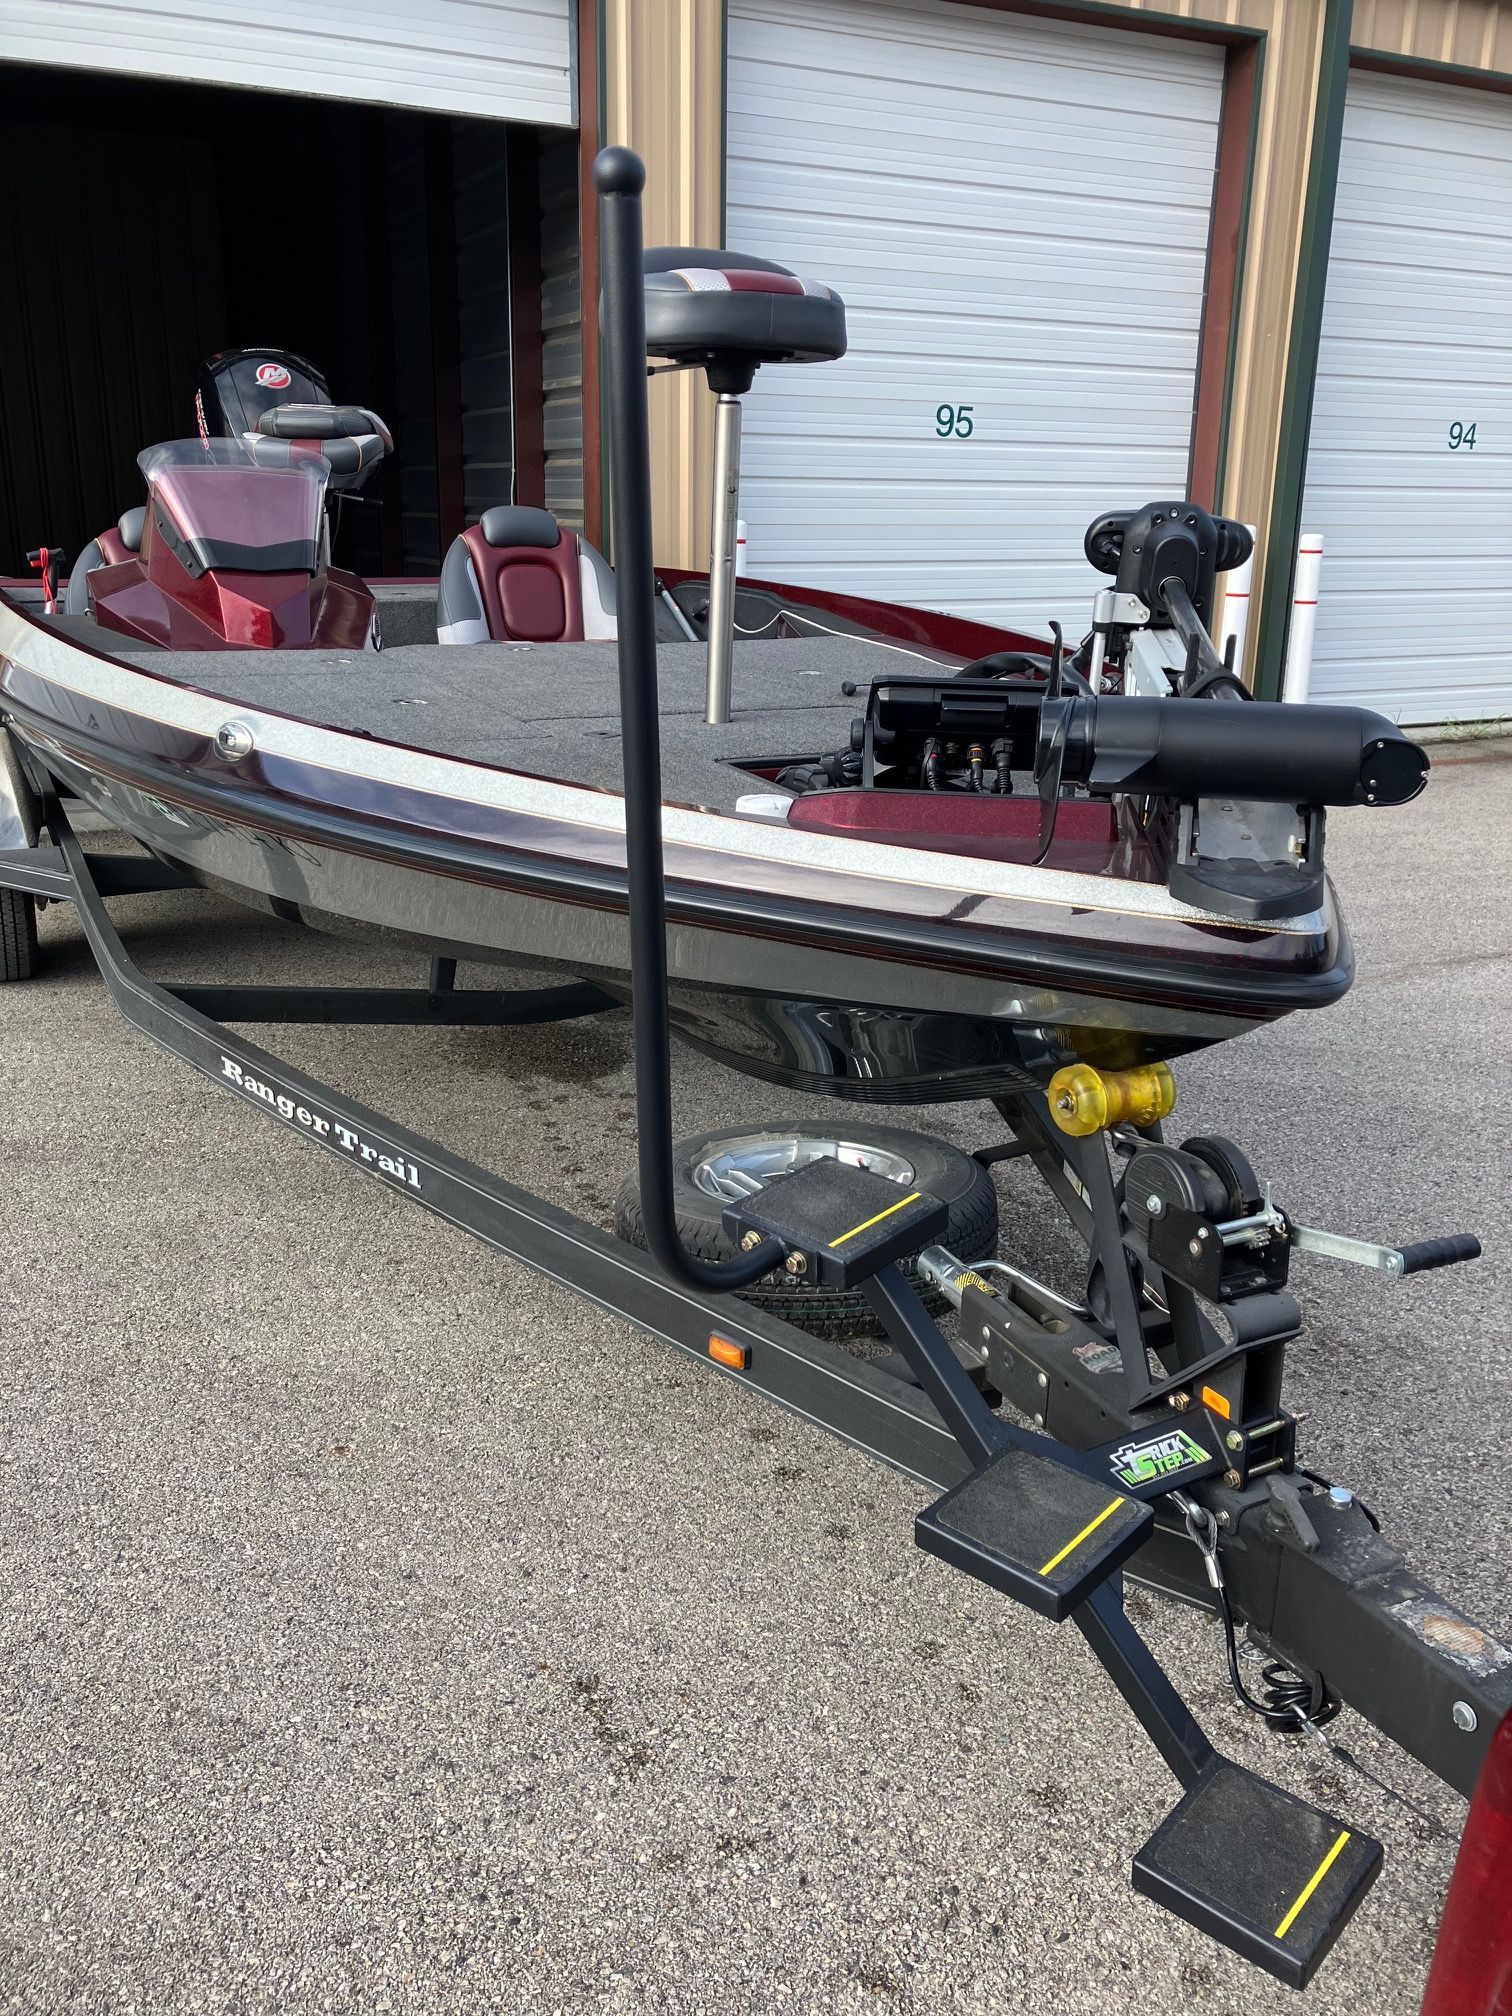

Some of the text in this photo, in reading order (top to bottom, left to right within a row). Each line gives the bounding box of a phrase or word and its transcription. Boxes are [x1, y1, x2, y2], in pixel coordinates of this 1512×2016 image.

[936, 404, 974, 438] 95
[1448, 421, 1477, 450] 94
[221, 1056, 422, 1190] Ranger Trail
[1081, 1346, 1117, 1365] ROAD
